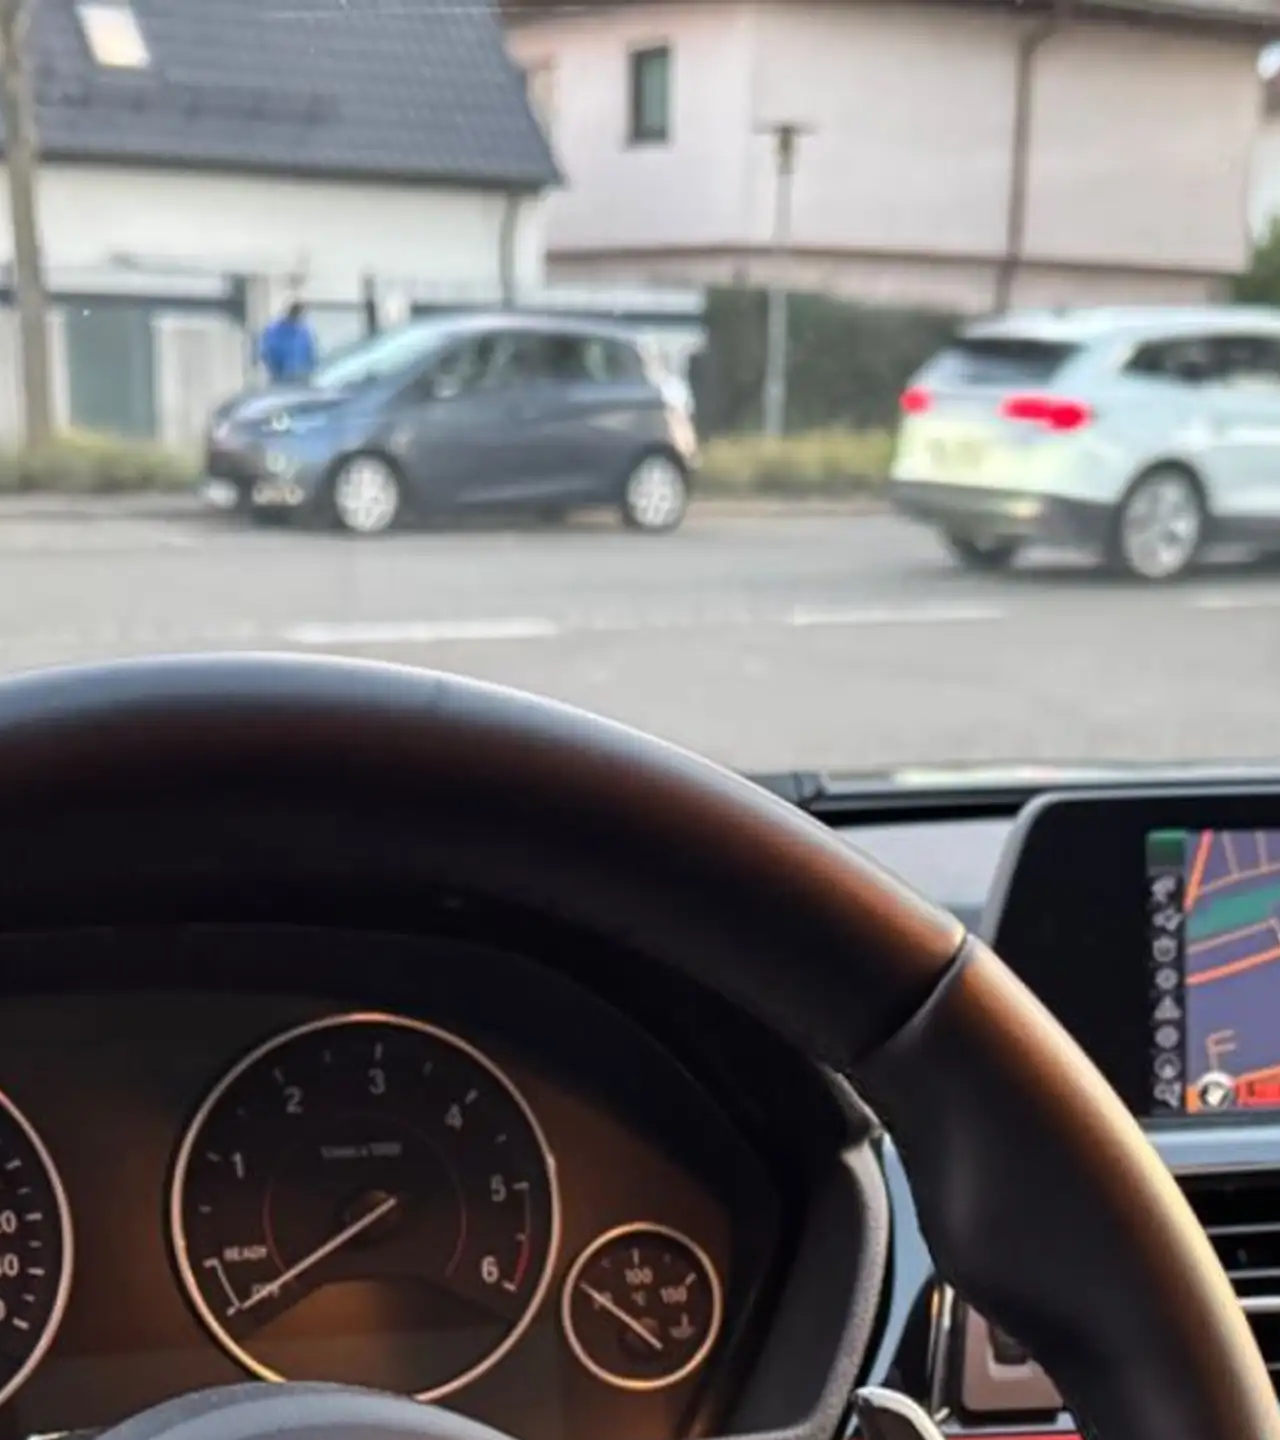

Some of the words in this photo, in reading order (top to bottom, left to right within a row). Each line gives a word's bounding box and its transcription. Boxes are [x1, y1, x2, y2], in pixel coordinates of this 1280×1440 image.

[368, 1068, 386, 1095] 3
[285, 1086, 303, 1114] 2
[445, 1104, 463, 1129] 4
[231, 1151, 245, 1179] 1
[489, 1175, 507, 1202] 5
[222, 1245, 268, 1262] READY
[481, 1256, 499, 1283] 6
[623, 1266, 654, 1286] 100
